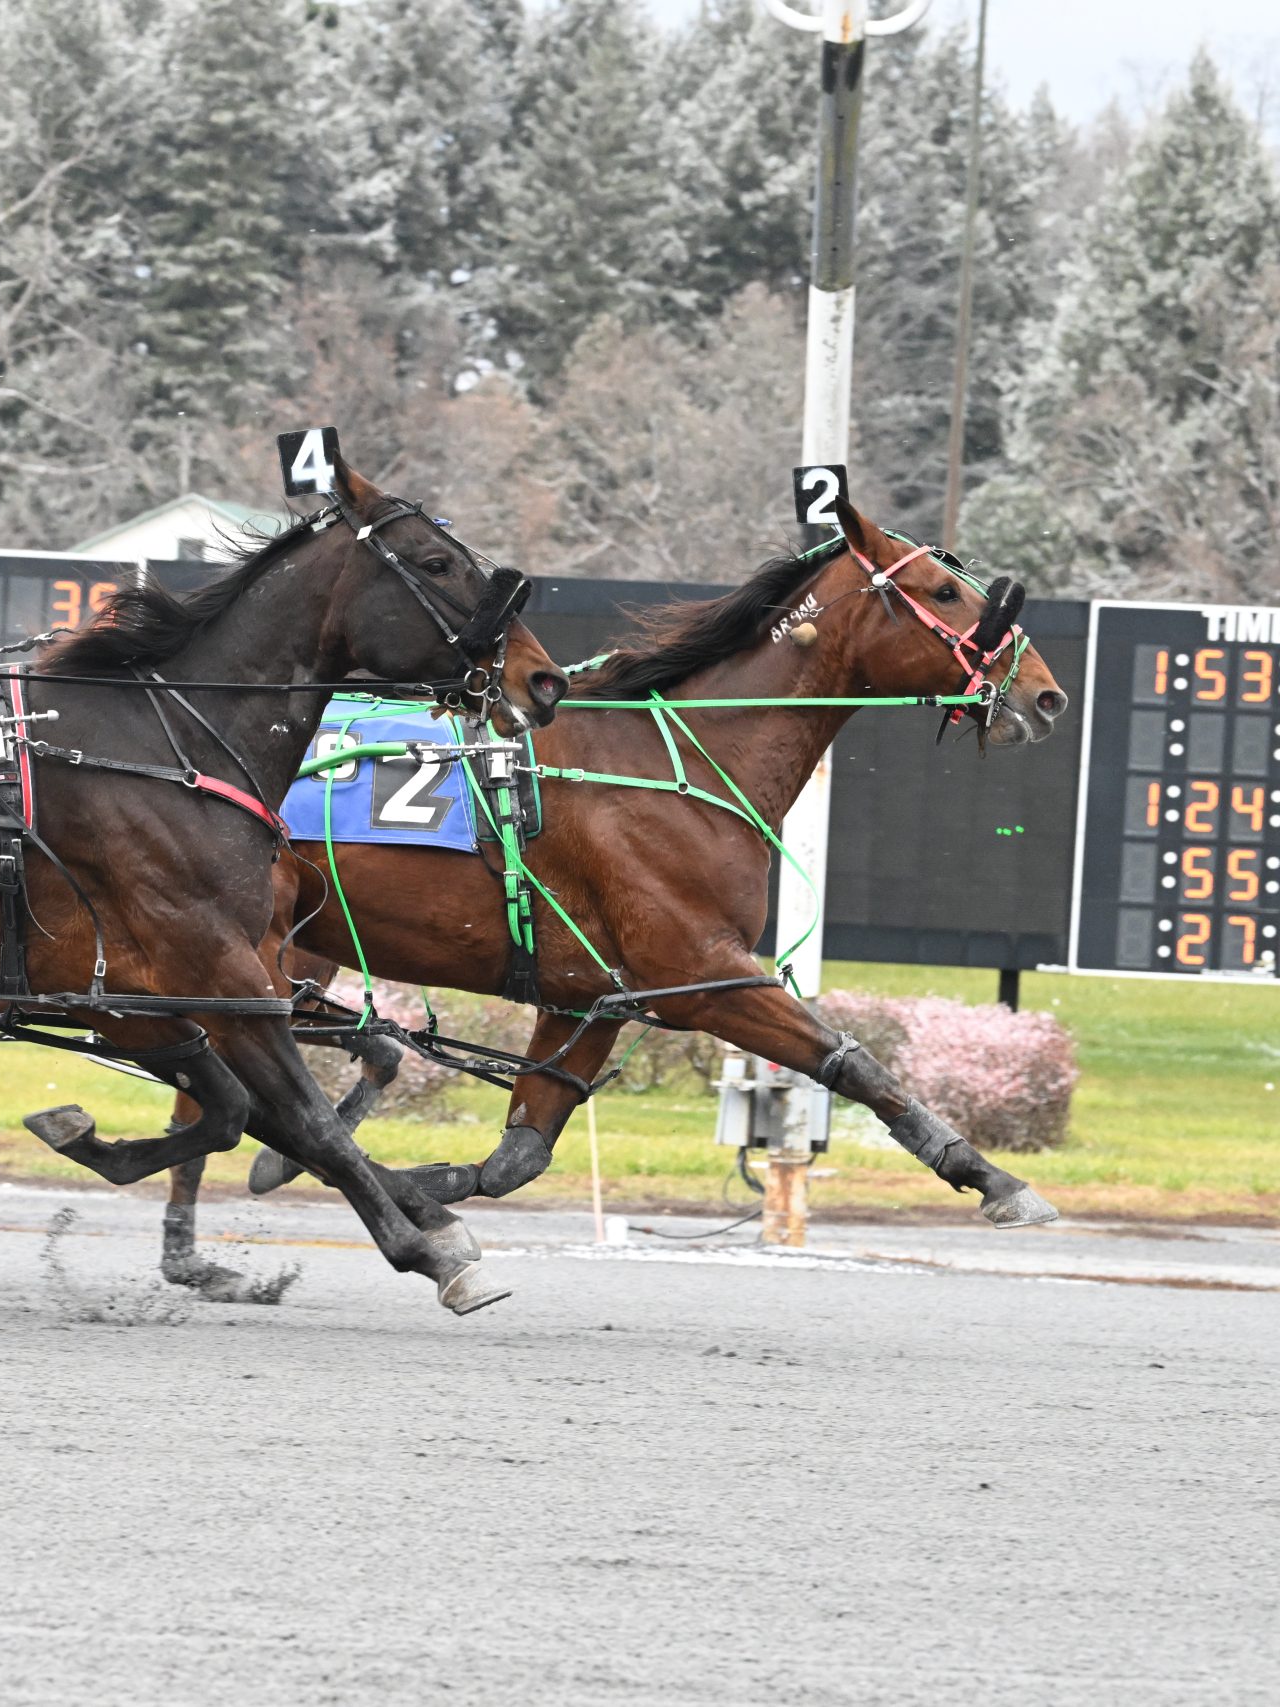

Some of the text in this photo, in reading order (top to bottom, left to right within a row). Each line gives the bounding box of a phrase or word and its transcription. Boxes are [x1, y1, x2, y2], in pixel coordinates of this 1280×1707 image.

[291, 429, 335, 492] 4
[802, 468, 840, 523] 2
[379, 750, 436, 824] 2
